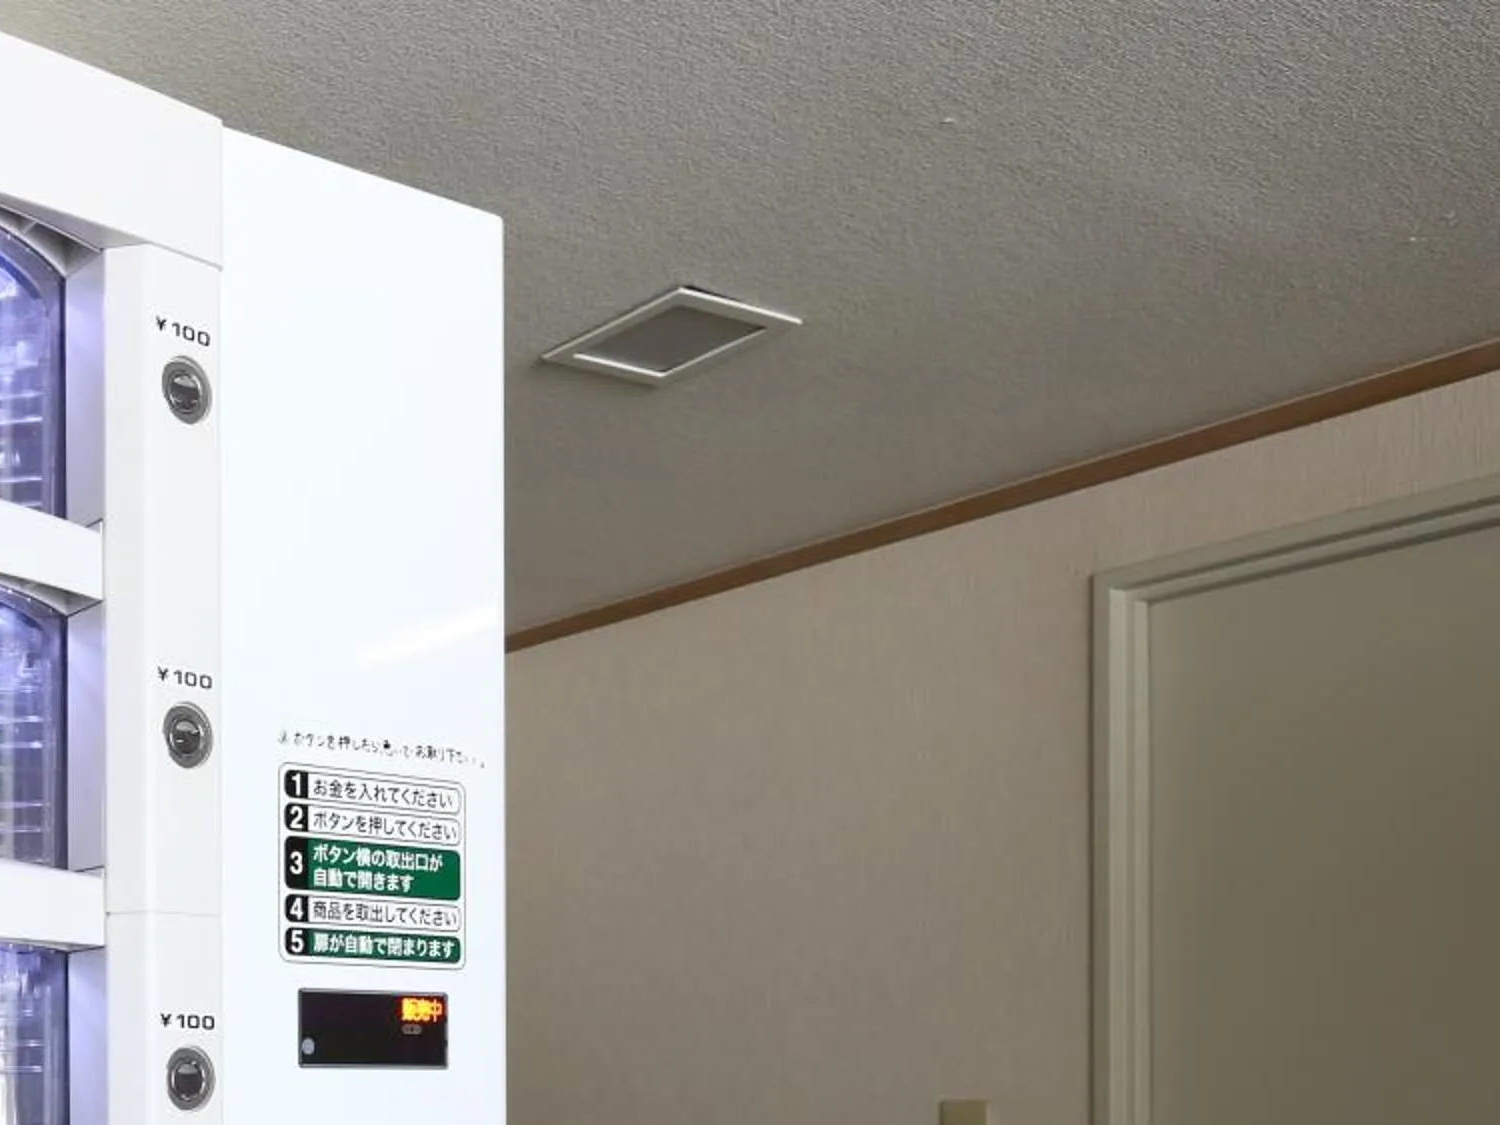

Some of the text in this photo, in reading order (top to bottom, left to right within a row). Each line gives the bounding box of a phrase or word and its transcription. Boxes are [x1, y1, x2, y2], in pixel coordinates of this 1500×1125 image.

[291, 774, 453, 808] 1 お金を入れてください
[289, 806, 457, 841] 2 ボタンを押してください
[289, 843, 443, 875] 3 ボタン横の取出口が
[313, 867, 415, 893] 自動で開きます
[289, 896, 457, 927] 4 商品を取出してください
[290, 929, 305, 953] 5
